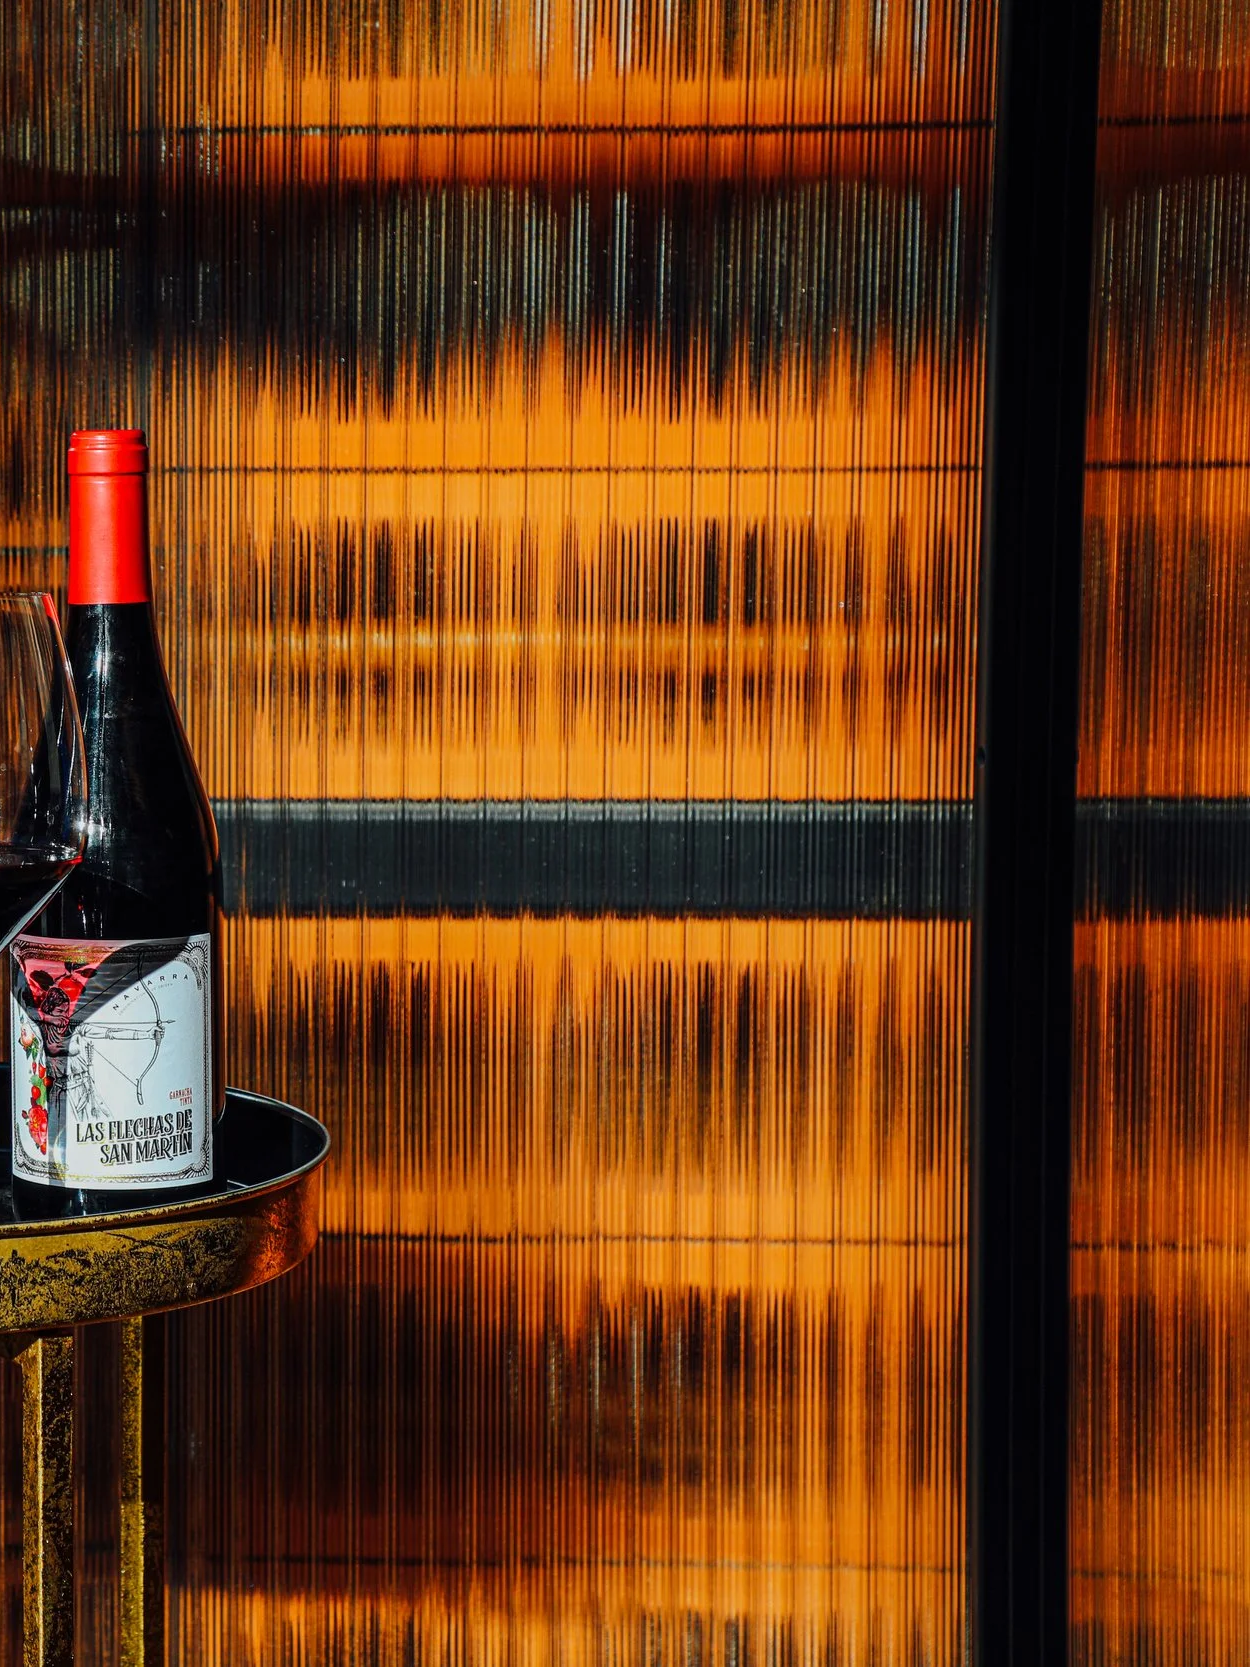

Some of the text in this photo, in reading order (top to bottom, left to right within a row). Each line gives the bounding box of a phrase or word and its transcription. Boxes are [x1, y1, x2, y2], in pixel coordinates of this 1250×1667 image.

[112, 974, 189, 1011] NAVARRA
[76, 1109, 192, 1144] LAS FLECHAS DE
[100, 1142, 133, 1166] SAN
